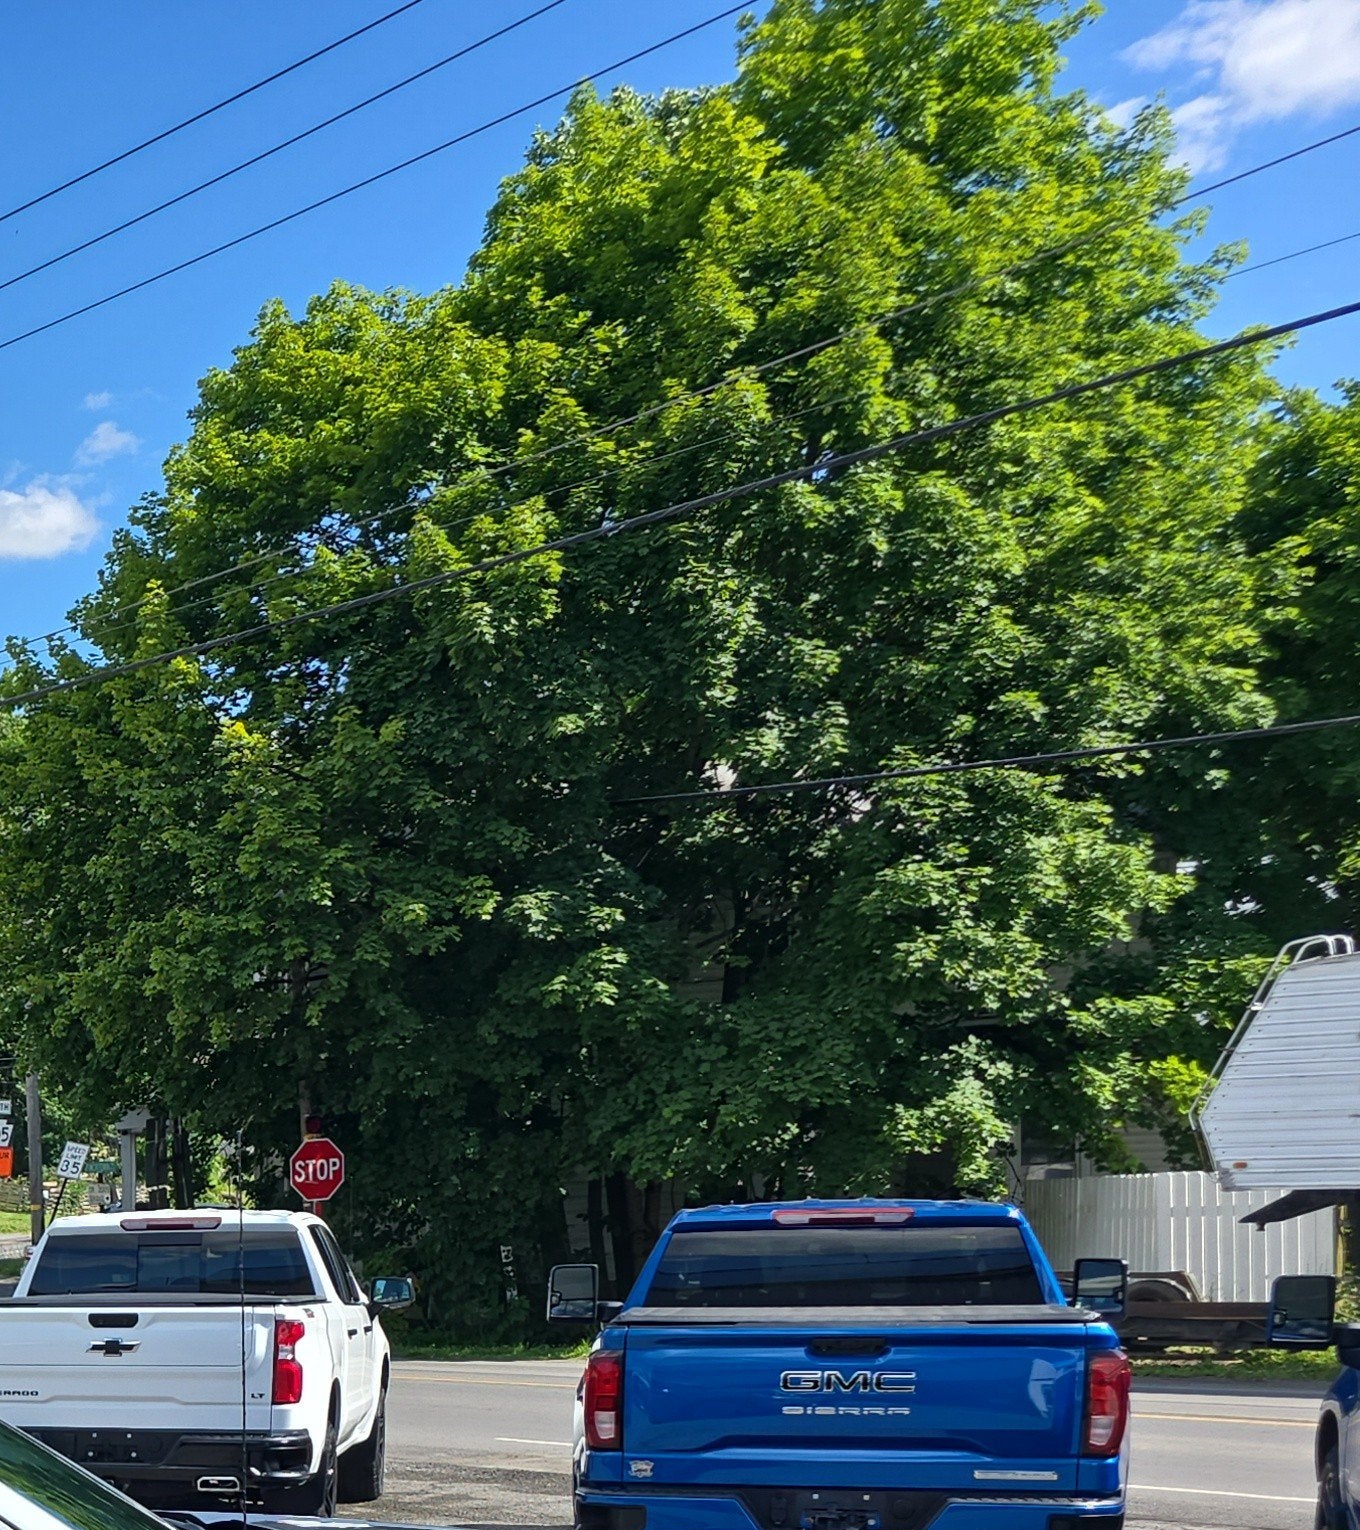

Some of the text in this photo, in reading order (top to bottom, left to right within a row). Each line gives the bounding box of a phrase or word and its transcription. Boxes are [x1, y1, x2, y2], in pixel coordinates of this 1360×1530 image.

[60, 1159, 81, 1174] 35
[294, 1158, 340, 1183] STOP
[780, 1370, 917, 1394] GMC
[782, 1406, 911, 1416] SIERRA
